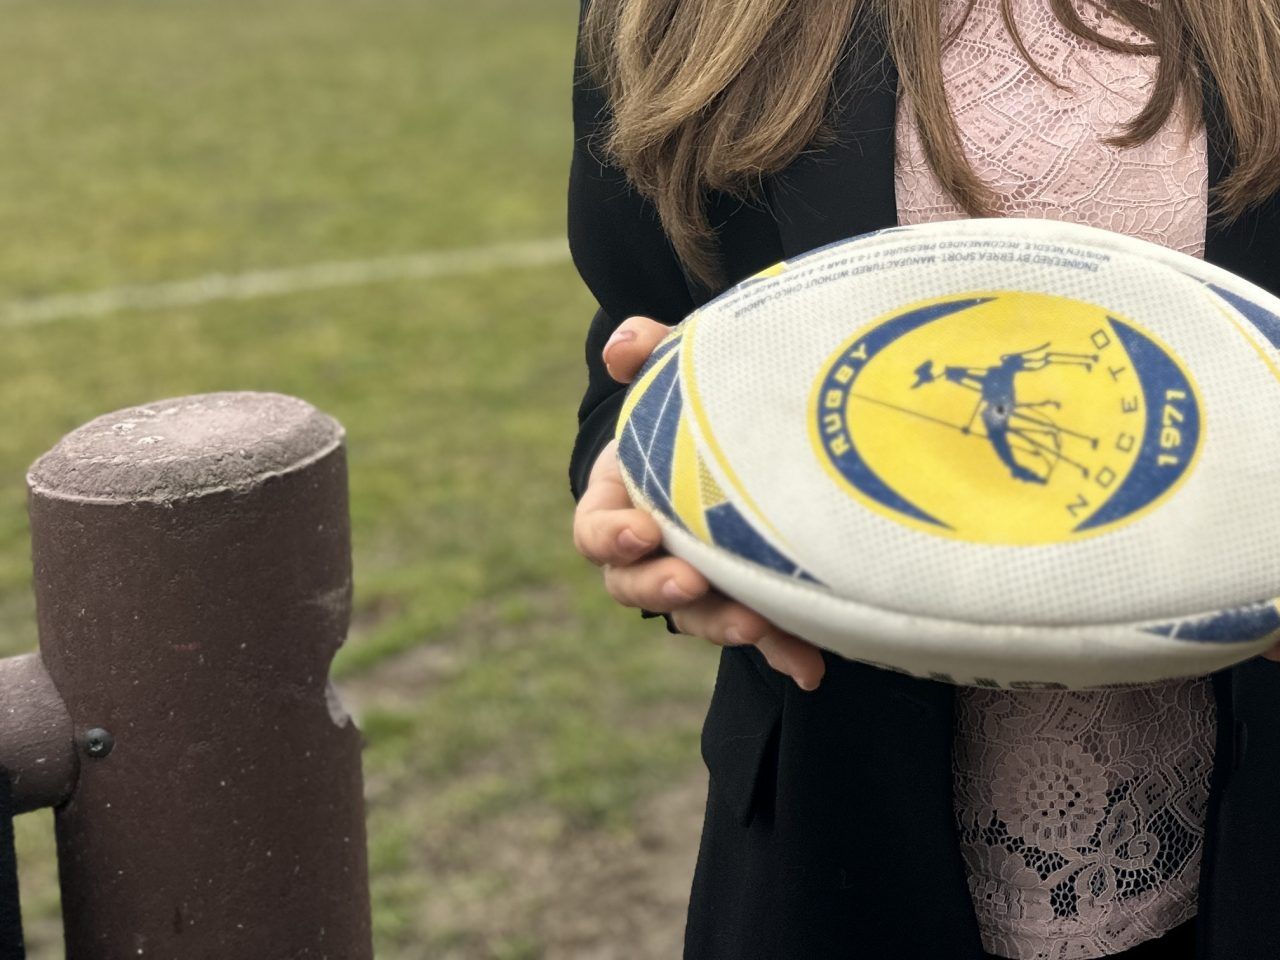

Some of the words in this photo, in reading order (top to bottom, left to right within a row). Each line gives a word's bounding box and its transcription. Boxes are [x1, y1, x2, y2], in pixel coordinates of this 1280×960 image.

[883, 243, 937, 257] PRESSURE
[939, 240, 1020, 249] RECOMMENDED
[851, 256, 936, 275] MANUFACTURED
[941, 251, 976, 262] SPORT
[1017, 253, 1031, 263] BY
[1033, 254, 1099, 272] ENGINEERED
[805, 269, 849, 289] WITHOUT
[823, 344, 870, 456] RUGBY
[1065, 328, 1139, 517] NOCETO
[1157, 389, 1186, 466] 1971
